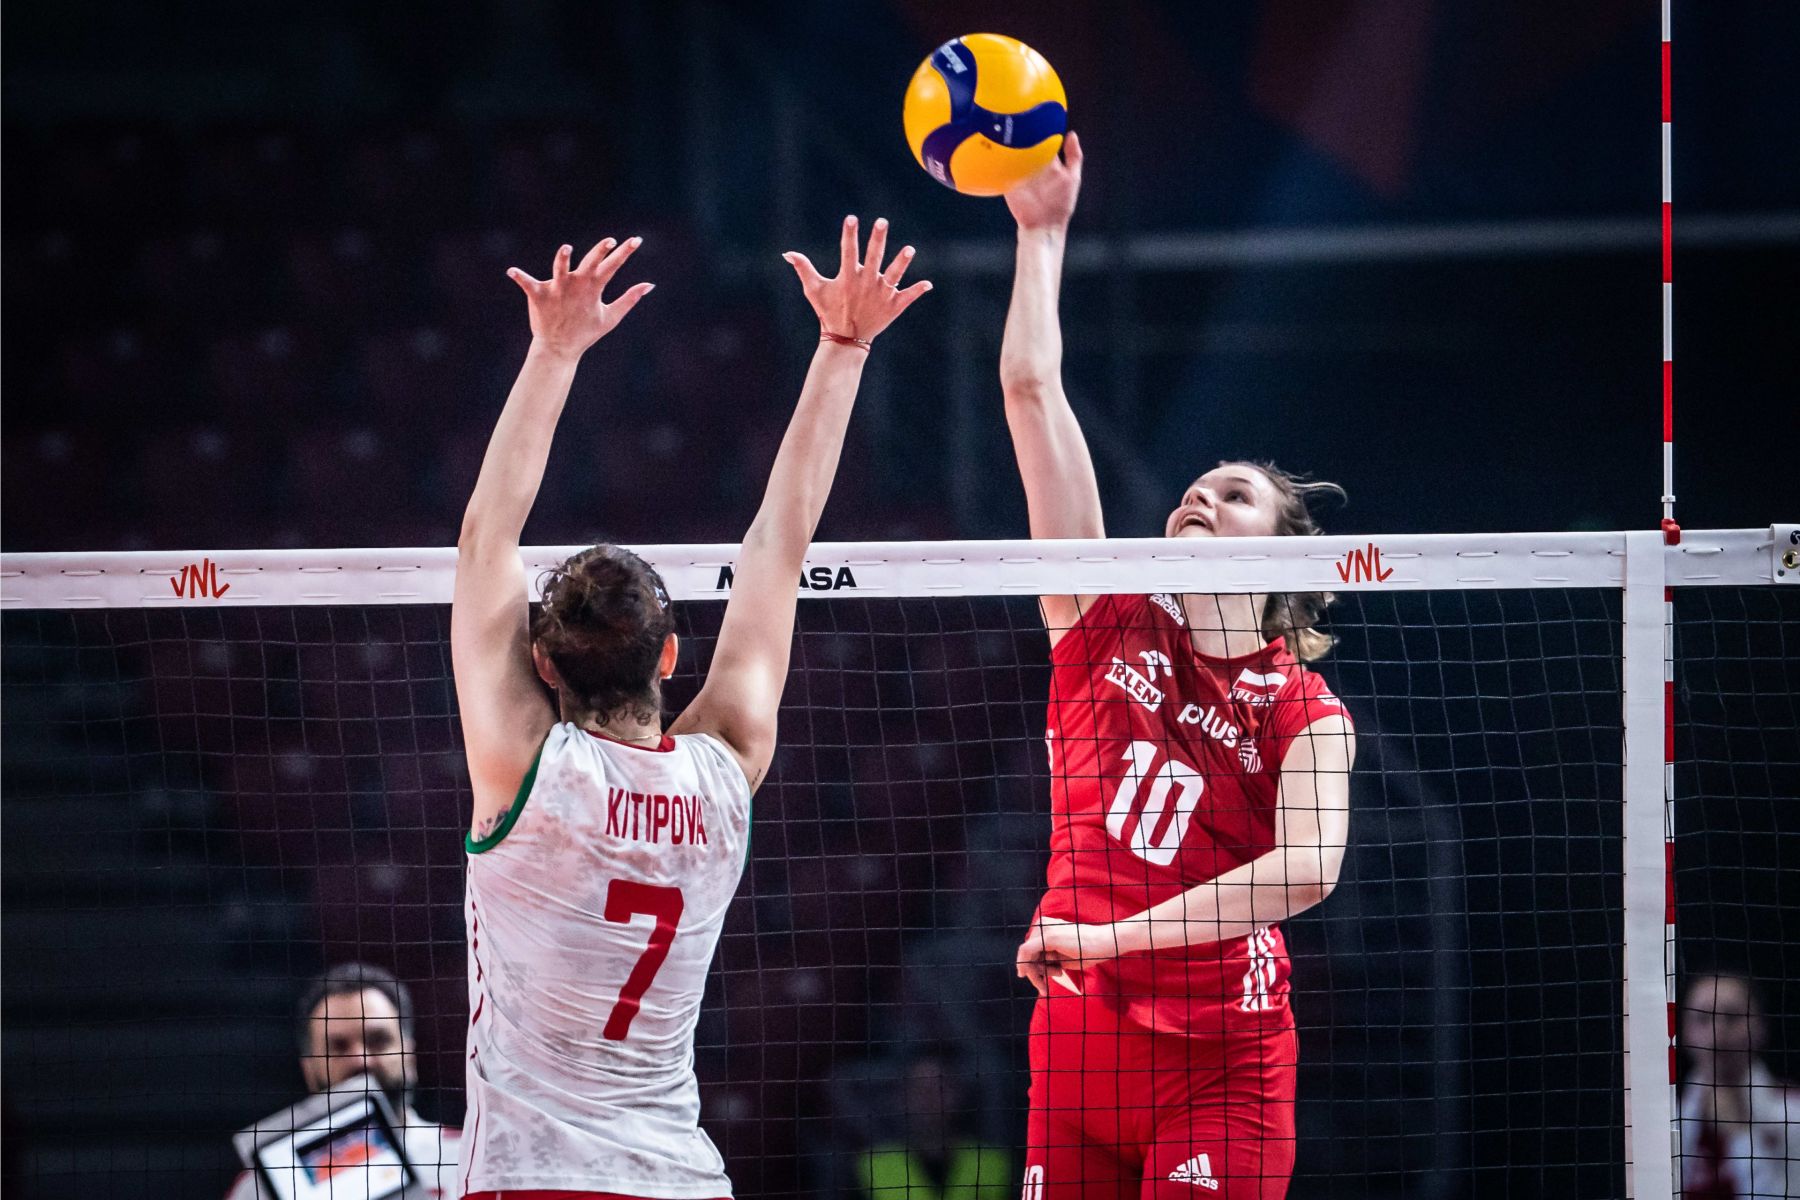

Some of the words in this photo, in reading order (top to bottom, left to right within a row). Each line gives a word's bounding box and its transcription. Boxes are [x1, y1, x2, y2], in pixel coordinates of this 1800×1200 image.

[171, 558, 230, 599] VNL
[716, 566, 857, 590] MSA
[1336, 543, 1393, 583] VNL
[1150, 594, 1184, 626] didas
[1106, 664, 1159, 706] RLEN
[1177, 704, 1238, 748] plus
[605, 787, 708, 845] KITIPOVA
[1106, 741, 1204, 866] 10
[603, 878, 684, 1041] 7
